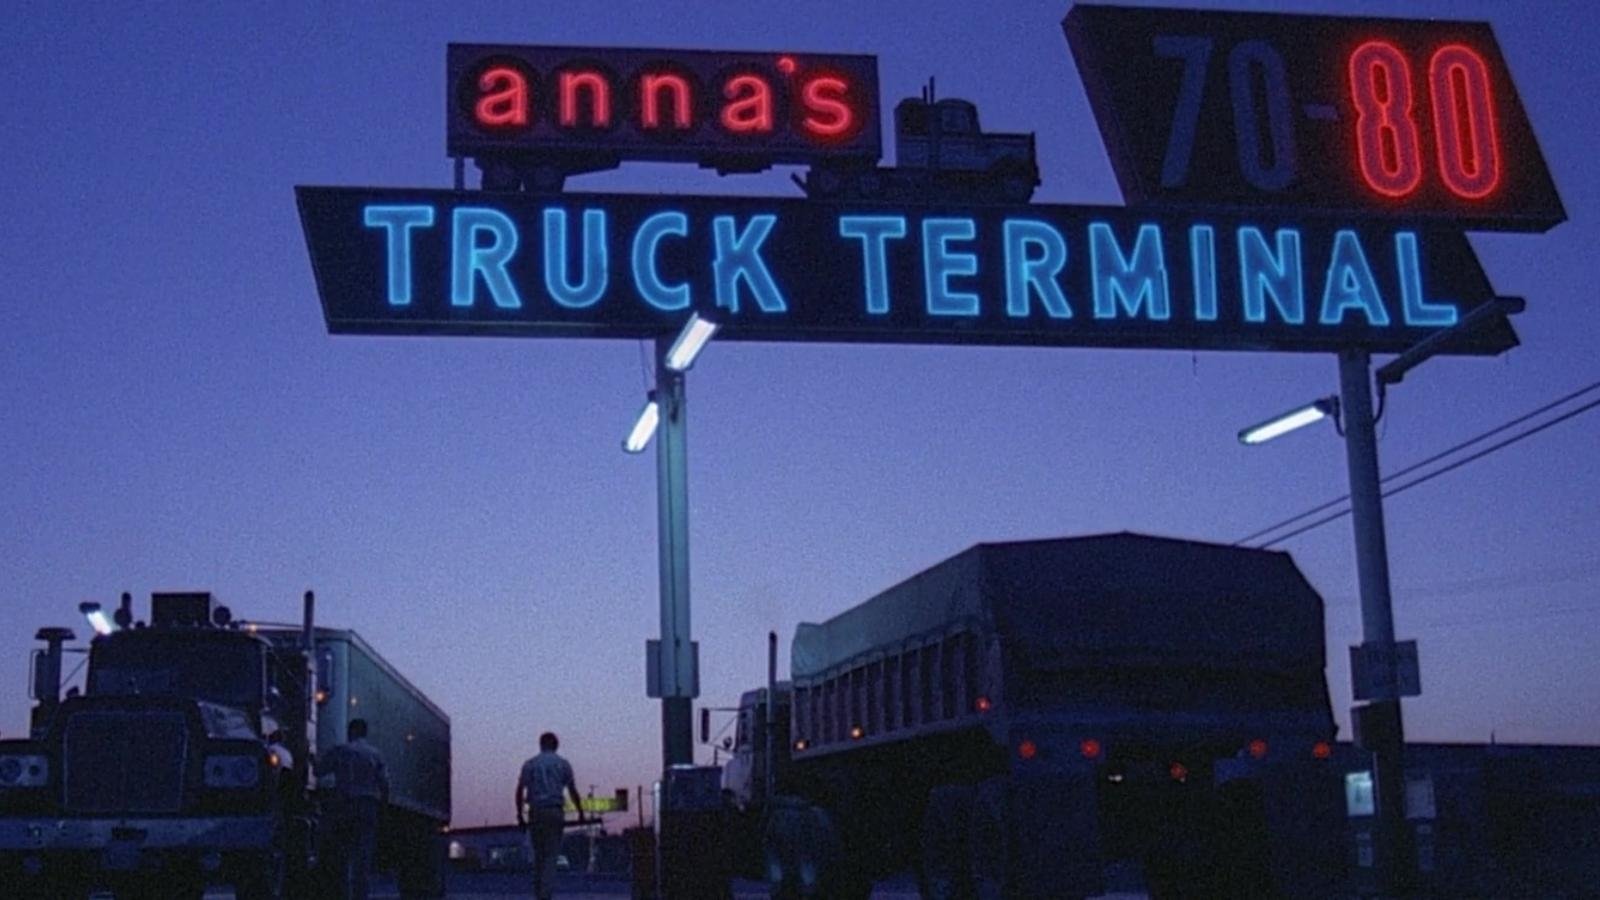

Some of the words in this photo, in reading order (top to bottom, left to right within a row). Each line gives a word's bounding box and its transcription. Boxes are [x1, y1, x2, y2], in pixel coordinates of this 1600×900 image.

[475, 57, 854, 135] anna's
[364, 205, 788, 313] TRUCK
[839, 216, 1459, 327] TERMINAL
